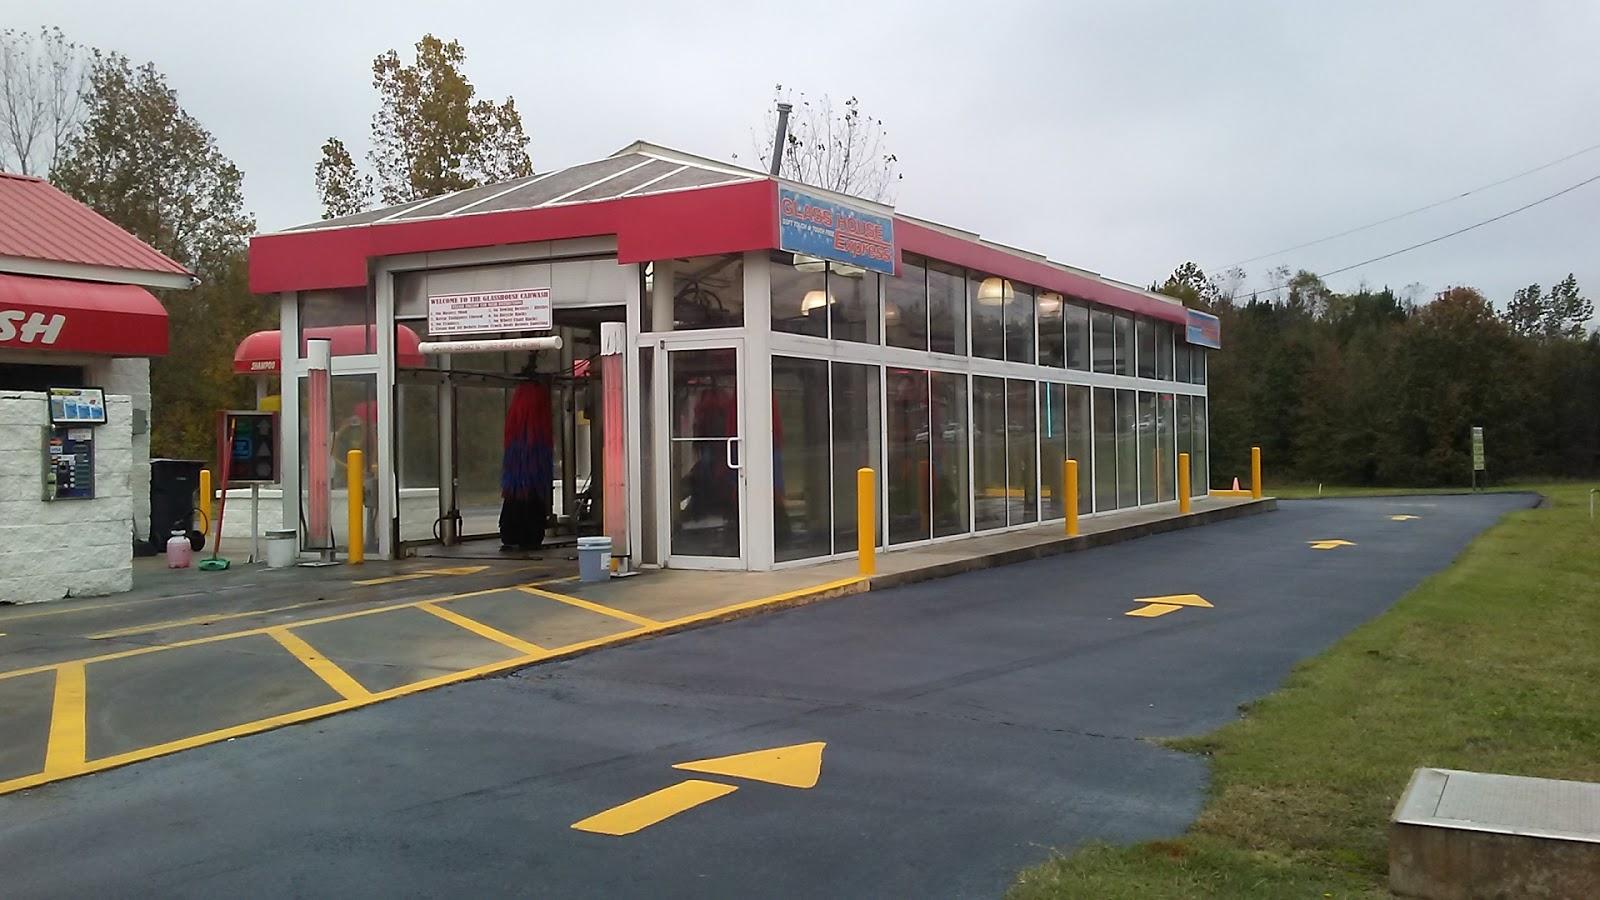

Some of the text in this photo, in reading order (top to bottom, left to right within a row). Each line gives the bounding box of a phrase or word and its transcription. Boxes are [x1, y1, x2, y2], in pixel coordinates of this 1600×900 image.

[782, 197, 883, 240] GLASS HOUSE
[834, 231, 891, 262] Express
[431, 297, 458, 305] WELCOME
